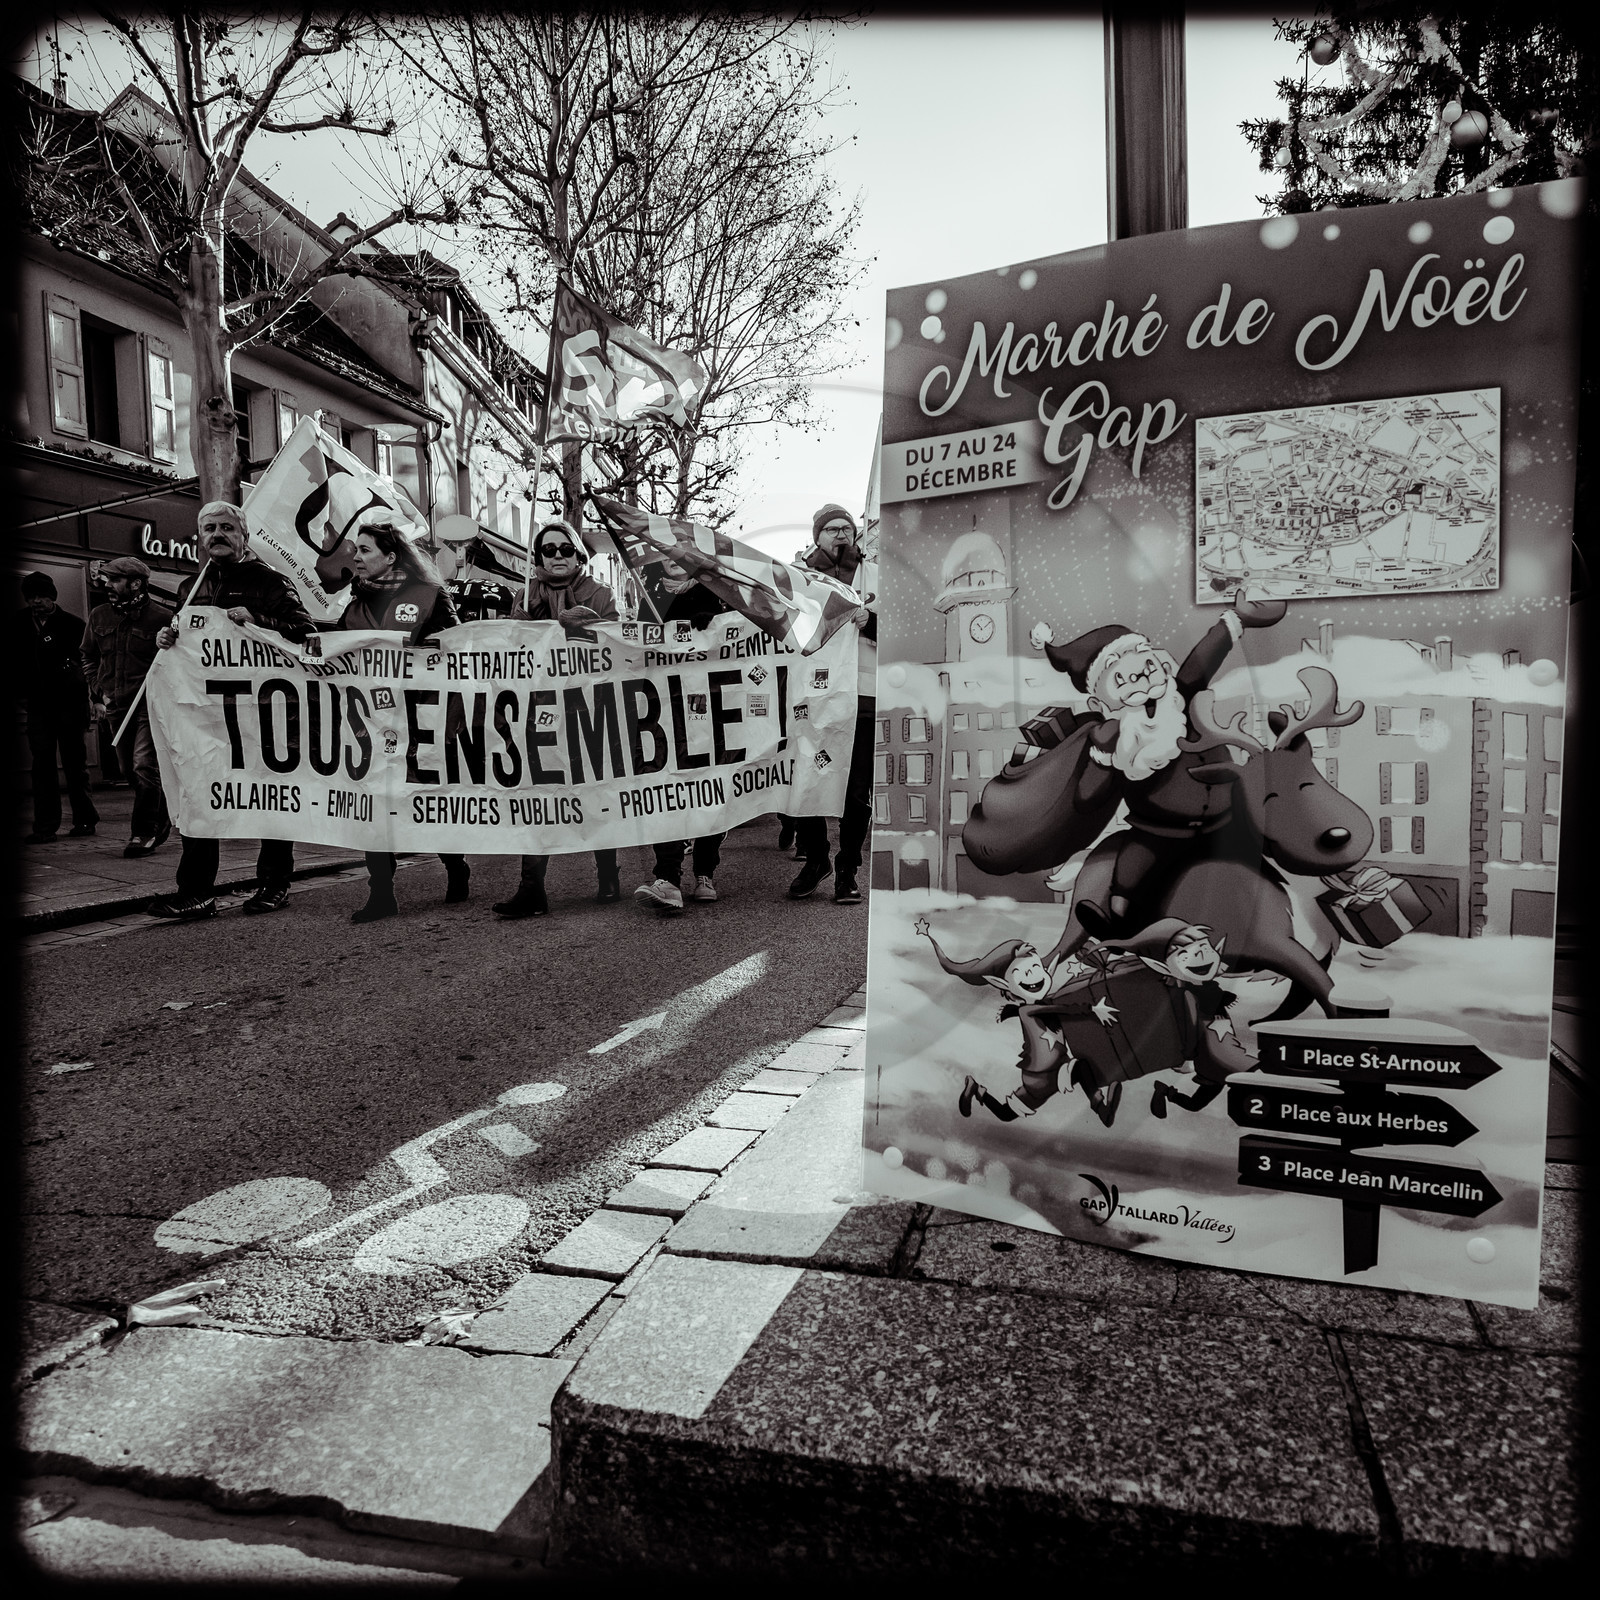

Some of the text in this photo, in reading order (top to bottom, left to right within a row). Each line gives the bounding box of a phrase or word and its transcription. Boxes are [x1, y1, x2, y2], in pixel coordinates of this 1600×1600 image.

[919, 252, 1529, 418] Marché de Noël
[906, 432, 1016, 466] DU 7 AU 24
[1038, 380, 1188, 511] Gap
[906, 459, 1017, 492] DÉCEMBRE
[142, 523, 167, 556] la
[256, 528, 298, 570] Fédération
[1336, 579, 1362, 588] Georges
[1393, 582, 1427, 590] Pompidou
[395, 603, 419, 615] FO
[395, 614, 417, 622] COM
[623, 627, 638, 637] cgt
[646, 626, 661, 639] FO
[677, 632, 692, 641] cgt
[547, 647, 613, 677] JEUNES
[644, 646, 708, 668] PRIVÉS
[375, 690, 390, 705] FO
[206, 678, 373, 781] TOUS
[404, 669, 746, 788] ENSEMBLE
[210, 782, 301, 812] SALAIRES
[327, 789, 373, 822] EMPLOI
[412, 795, 500, 825] SERVICES
[510, 796, 583, 825] PUBLICS
[619, 777, 725, 818] PROTECTION
[1278, 1046, 1461, 1074] 1 Place St-Arnoux
[1249, 1098, 1449, 1134] 2 Place aux Herbes
[1257, 1155, 1484, 1202] 3 Place Jean Marcellin
[1079, 1197, 1236, 1239] GAP TALLARD Vallées
